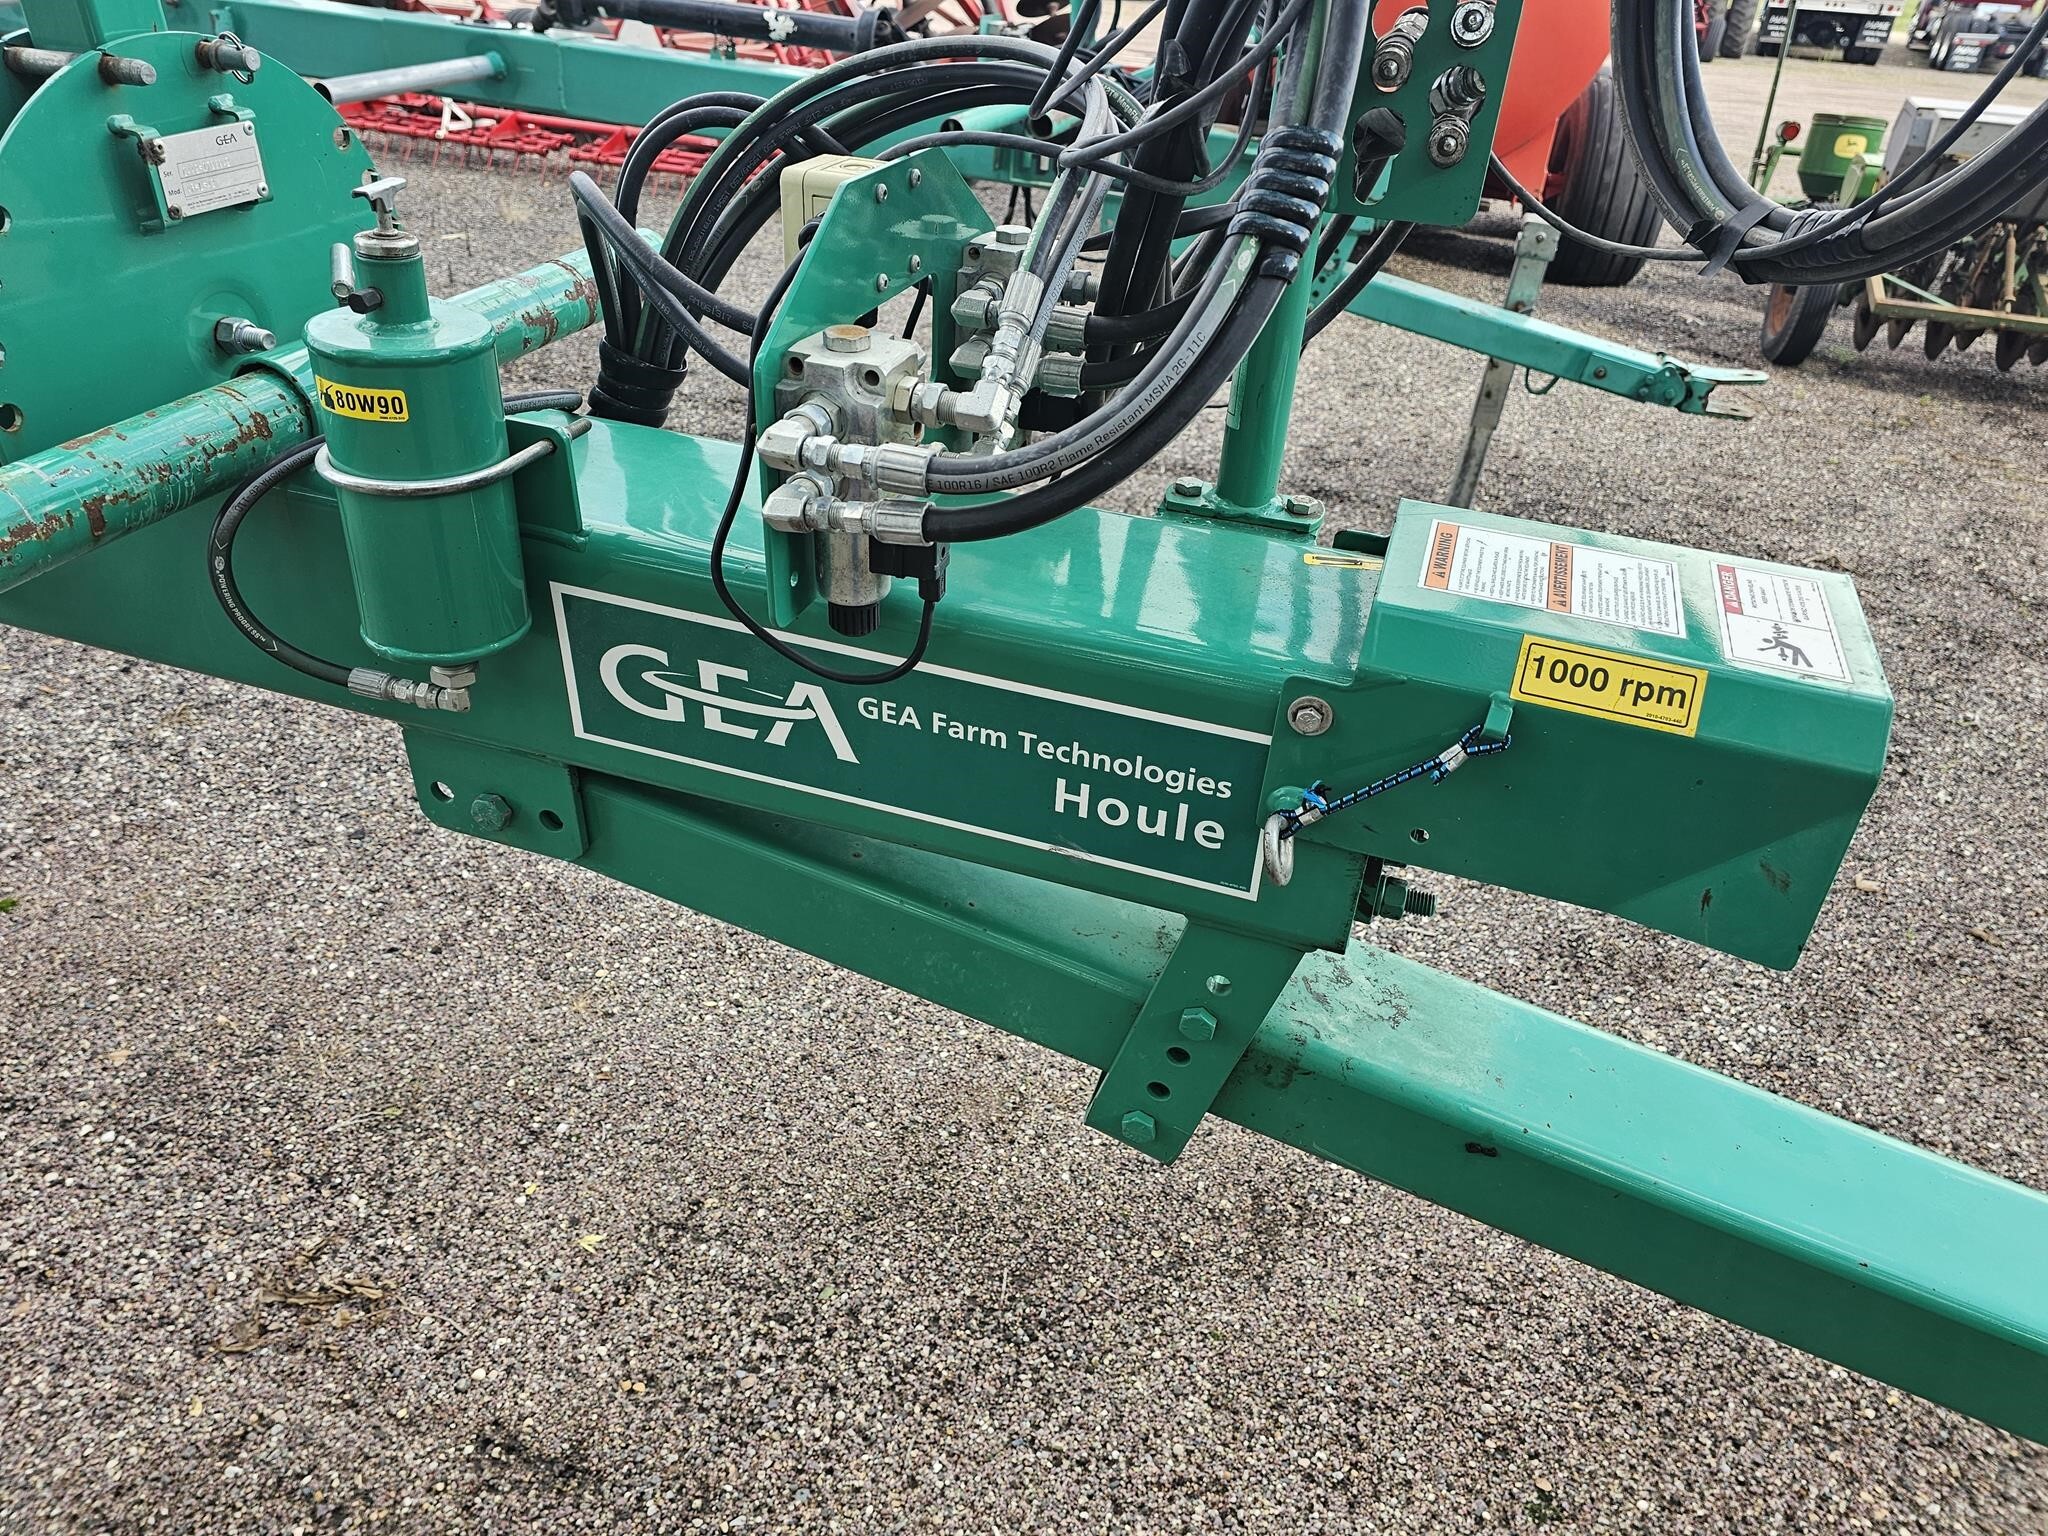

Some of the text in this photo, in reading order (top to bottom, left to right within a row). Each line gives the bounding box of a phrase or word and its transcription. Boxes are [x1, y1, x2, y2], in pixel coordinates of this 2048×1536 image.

[216, 133, 238, 146] GEA
[335, 390, 404, 415] 80W90
[937, 478, 981, 490] 100R16
[991, 473, 1015, 487] SAE
[1017, 459, 1057, 481] 100R2
[1056, 440, 1094, 466] Flame
[1093, 402, 1145, 447] Resistant
[1142, 372, 1174, 407] MSHA
[1167, 330, 1209, 375] 2G-11C
[1433, 532, 1453, 568] WARNING
[1553, 545, 1569, 599] AVERTISSEMENT
[214, 573, 238, 609] POWERING
[1722, 571, 1737, 600] DANGER
[600, 644, 860, 764] GEA
[1532, 655, 1687, 709] 1000 rpm
[858, 697, 1232, 800] GEA Farm Technologies
[1054, 777, 1226, 850] Houle
